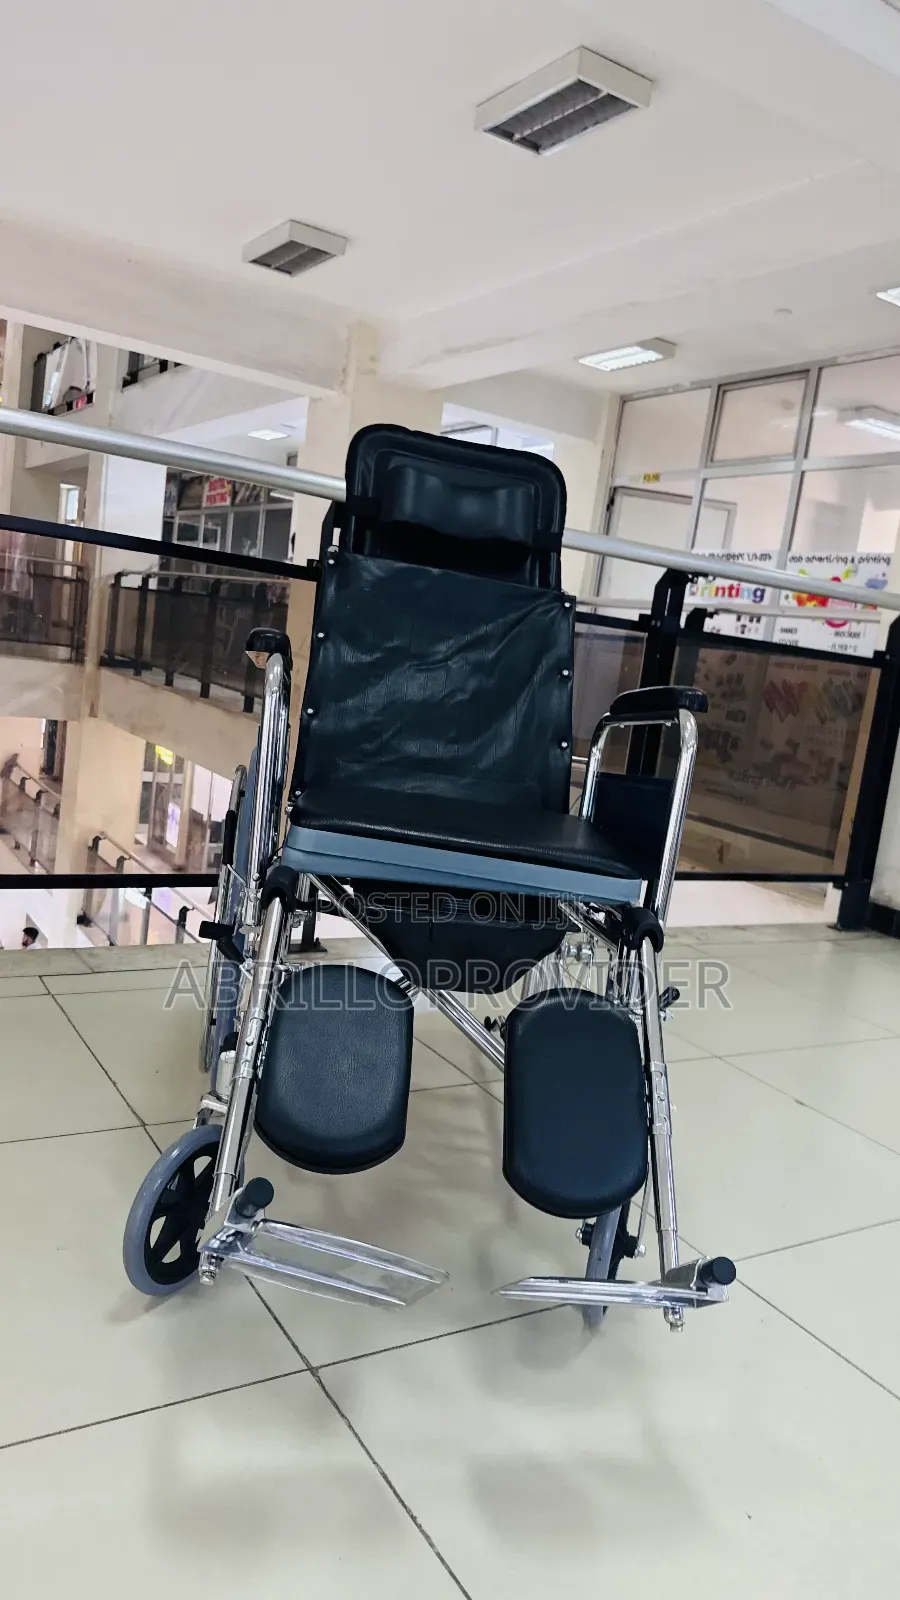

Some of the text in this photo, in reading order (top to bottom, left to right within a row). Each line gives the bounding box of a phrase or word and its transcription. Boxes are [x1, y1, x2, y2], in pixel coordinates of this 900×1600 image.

[206, 492, 227, 505] PRINTING
[804, 554, 848, 566] advertising
[857, 554, 891, 566] printing
[689, 583, 765, 604] printing
